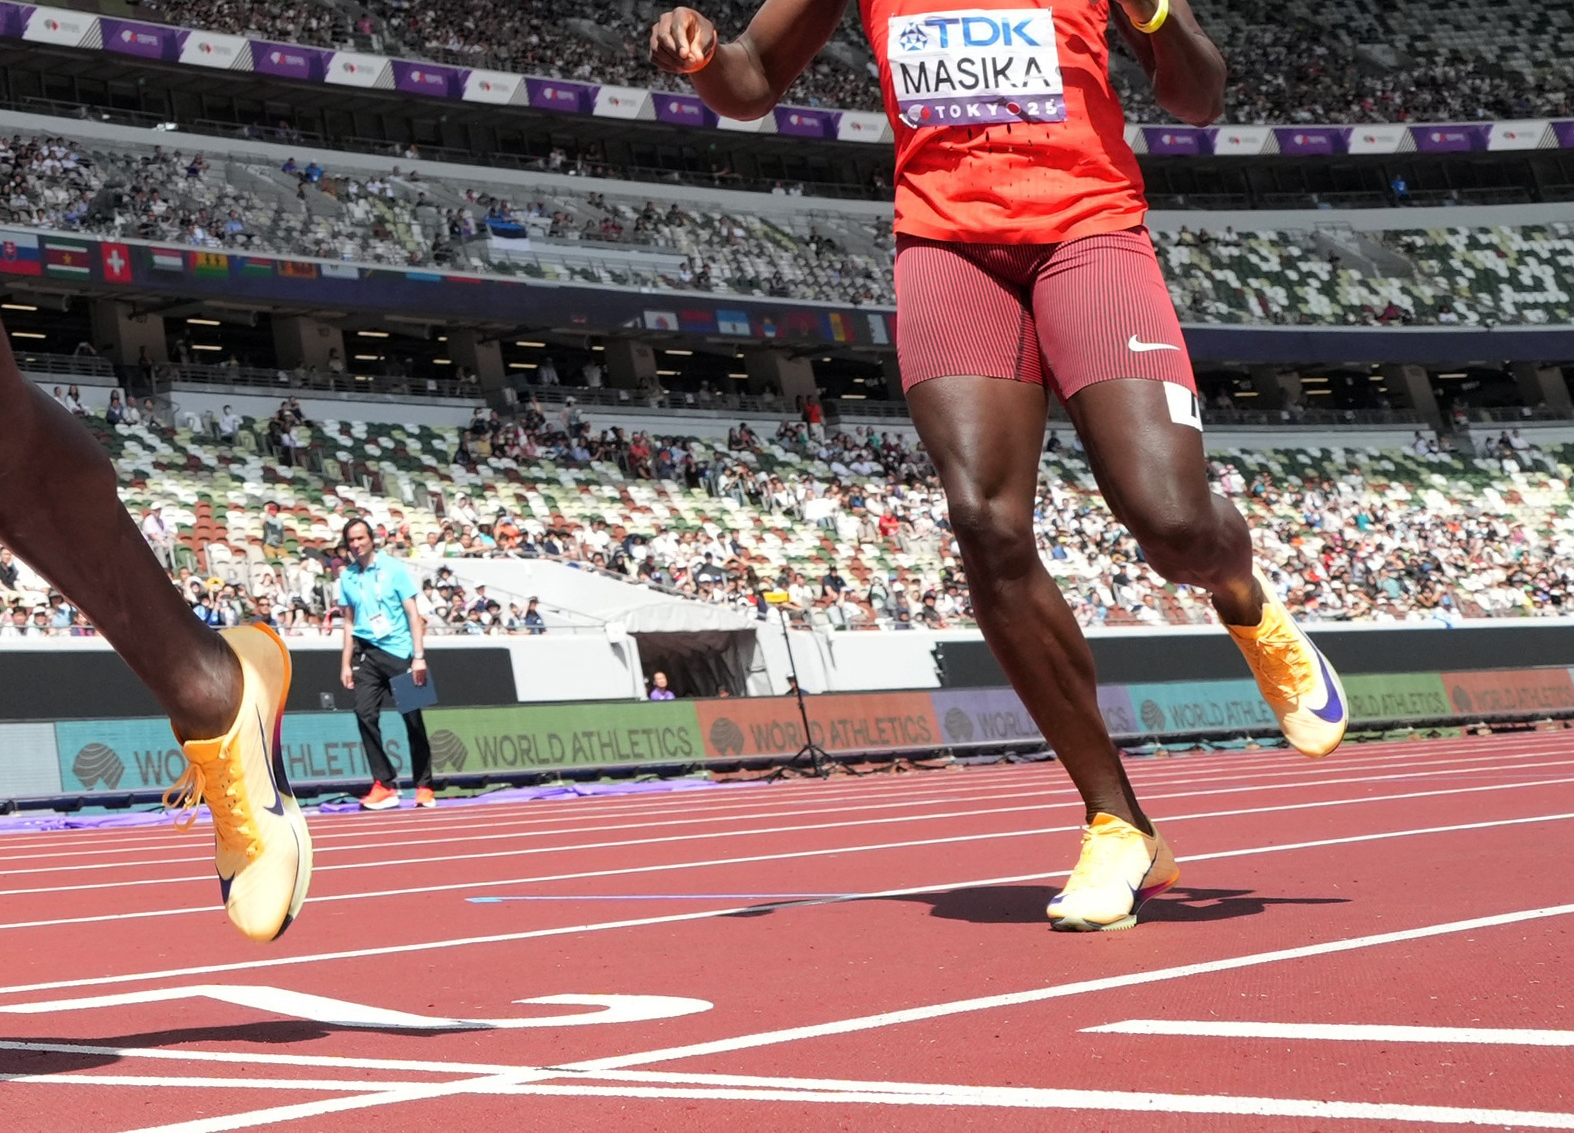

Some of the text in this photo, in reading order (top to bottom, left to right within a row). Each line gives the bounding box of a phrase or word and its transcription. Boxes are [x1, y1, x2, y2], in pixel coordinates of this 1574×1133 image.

[925, 16, 1041, 49] TDK
[900, 57, 1051, 94] MASIKA
[476, 727, 693, 767] WORLD ATHLETICS
[751, 715, 931, 752] WORLD ATHLETICS
